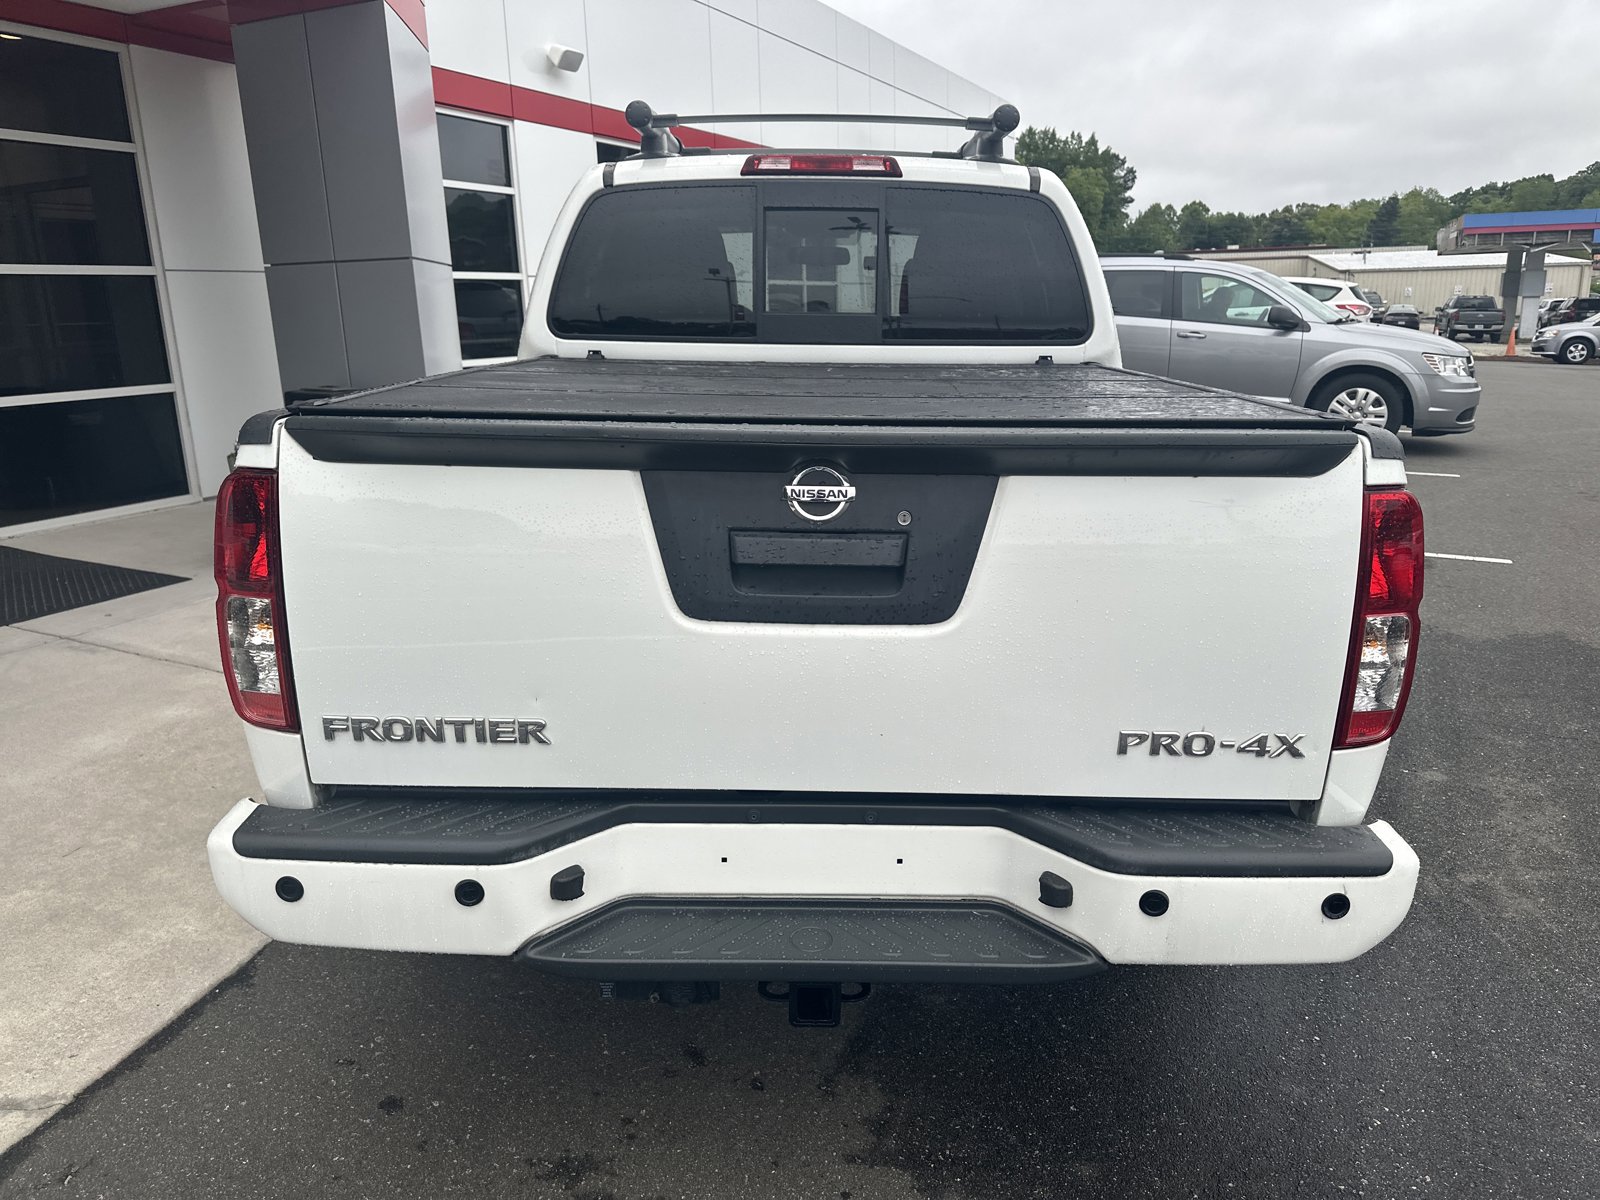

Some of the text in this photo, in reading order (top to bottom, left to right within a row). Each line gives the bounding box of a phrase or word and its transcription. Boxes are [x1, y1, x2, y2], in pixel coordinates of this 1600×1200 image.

[790, 488, 848, 499] NISSAN
[322, 715, 551, 745] FRONTIER
[1116, 730, 1307, 759] PRO-4X
